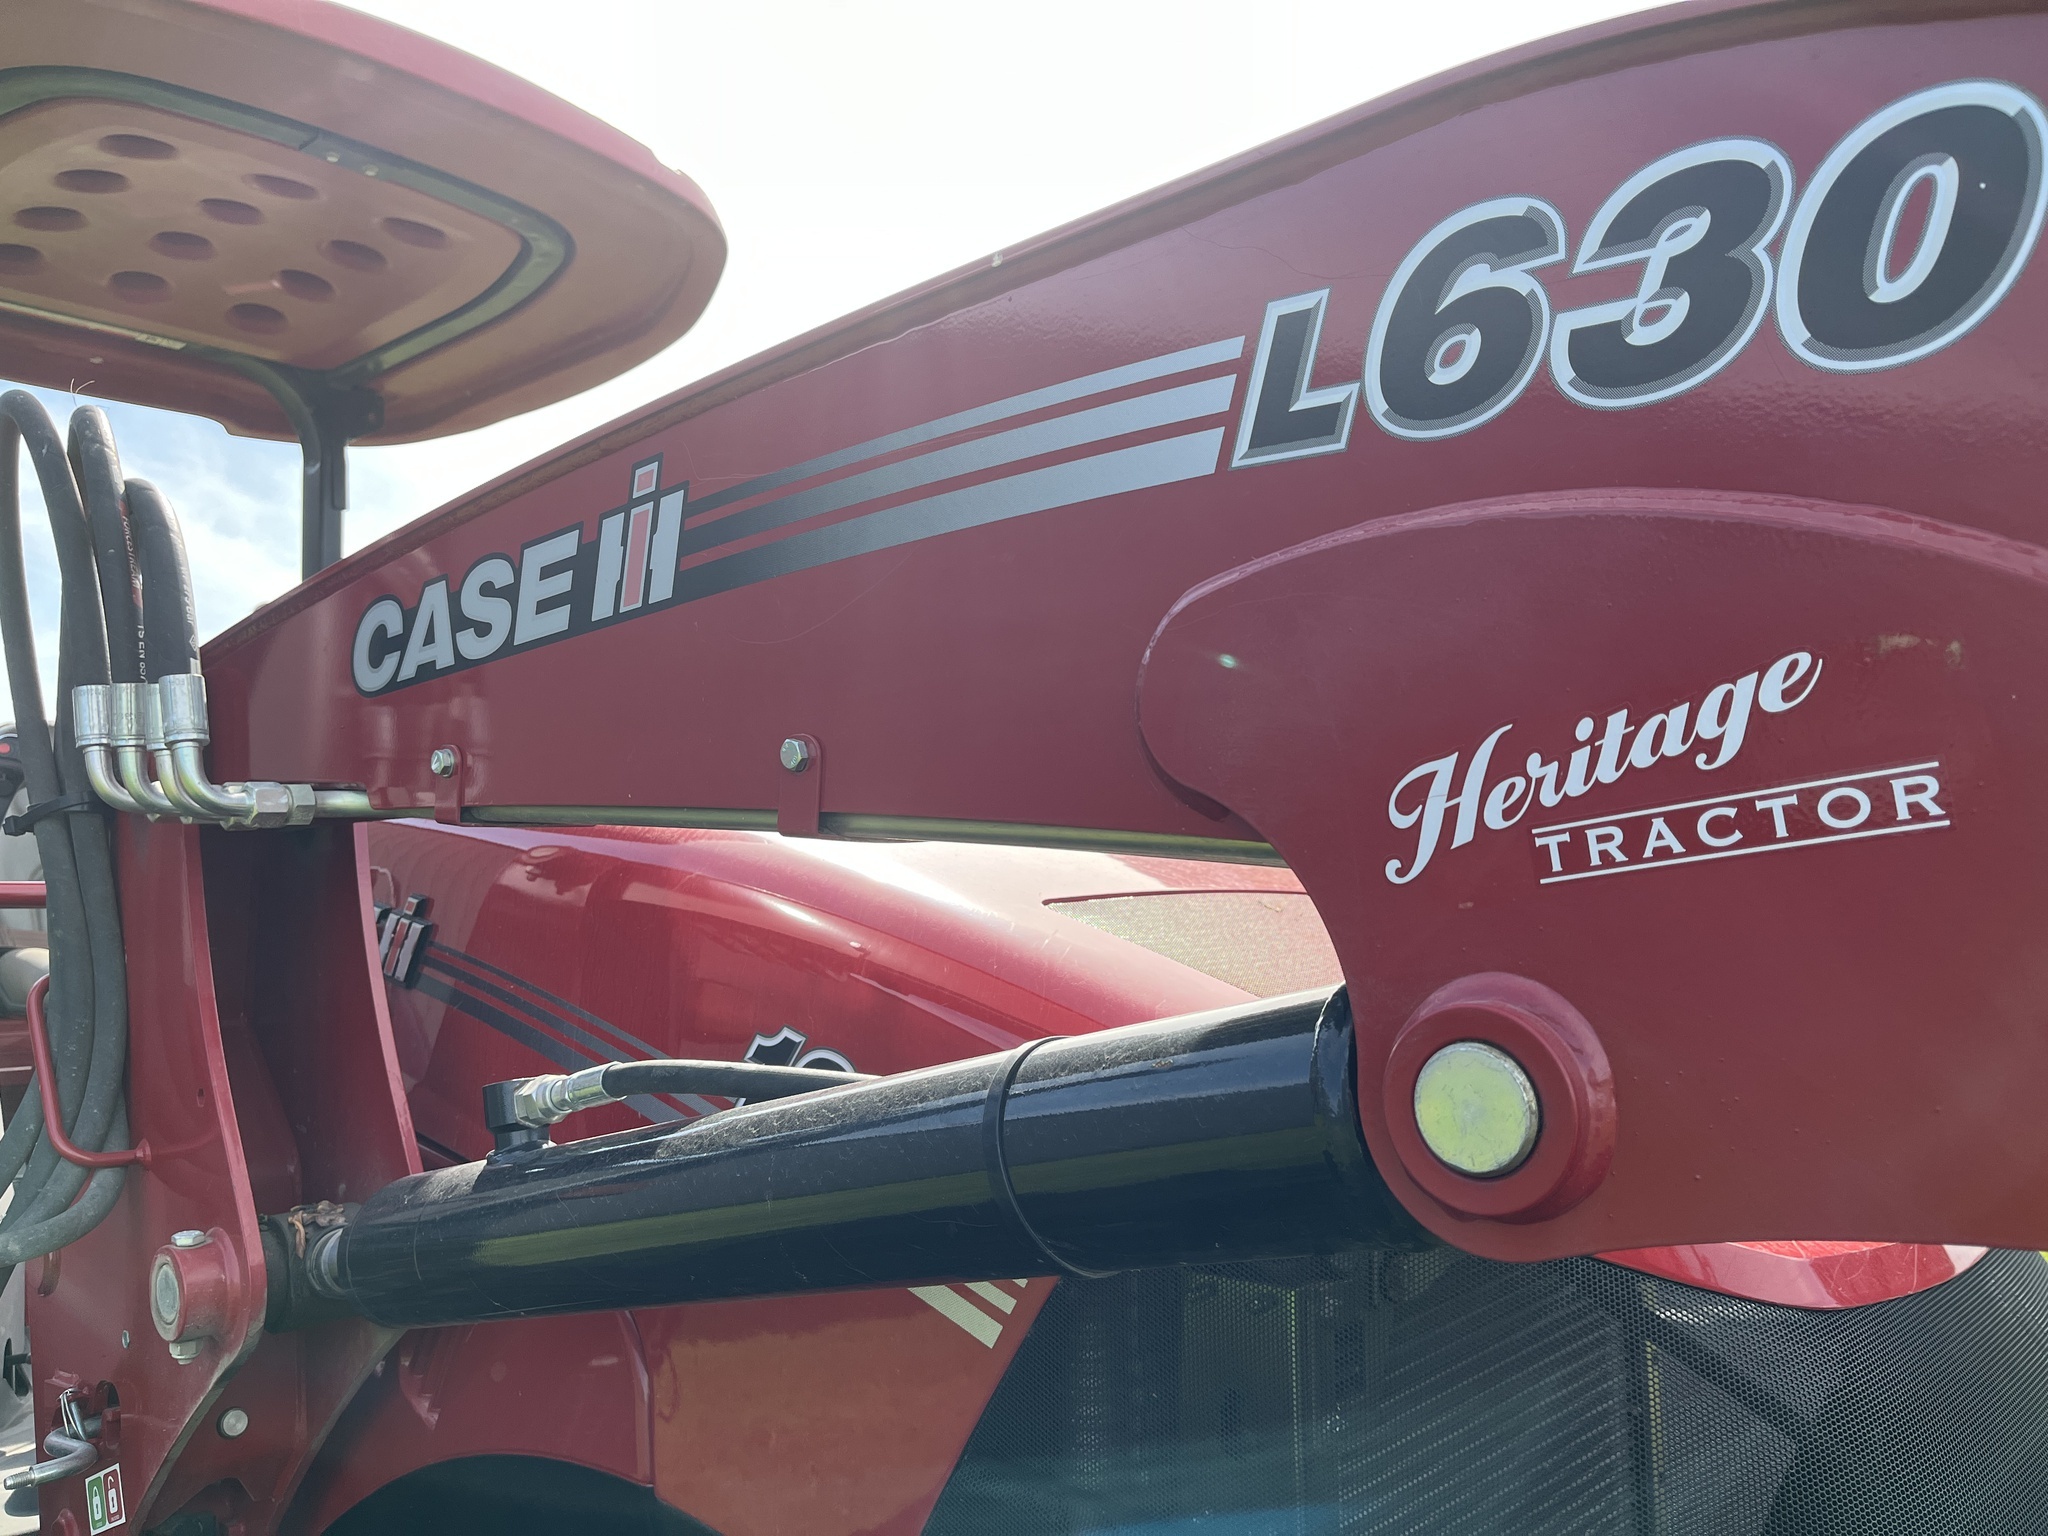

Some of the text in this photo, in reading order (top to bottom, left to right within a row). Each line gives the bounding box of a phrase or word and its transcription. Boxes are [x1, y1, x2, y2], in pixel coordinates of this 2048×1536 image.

[1231, 79, 2048, 469] L630
[353, 528, 580, 693] CASE
[1384, 649, 1825, 886] Heritage
[1535, 775, 1947, 873] TRACTOR
